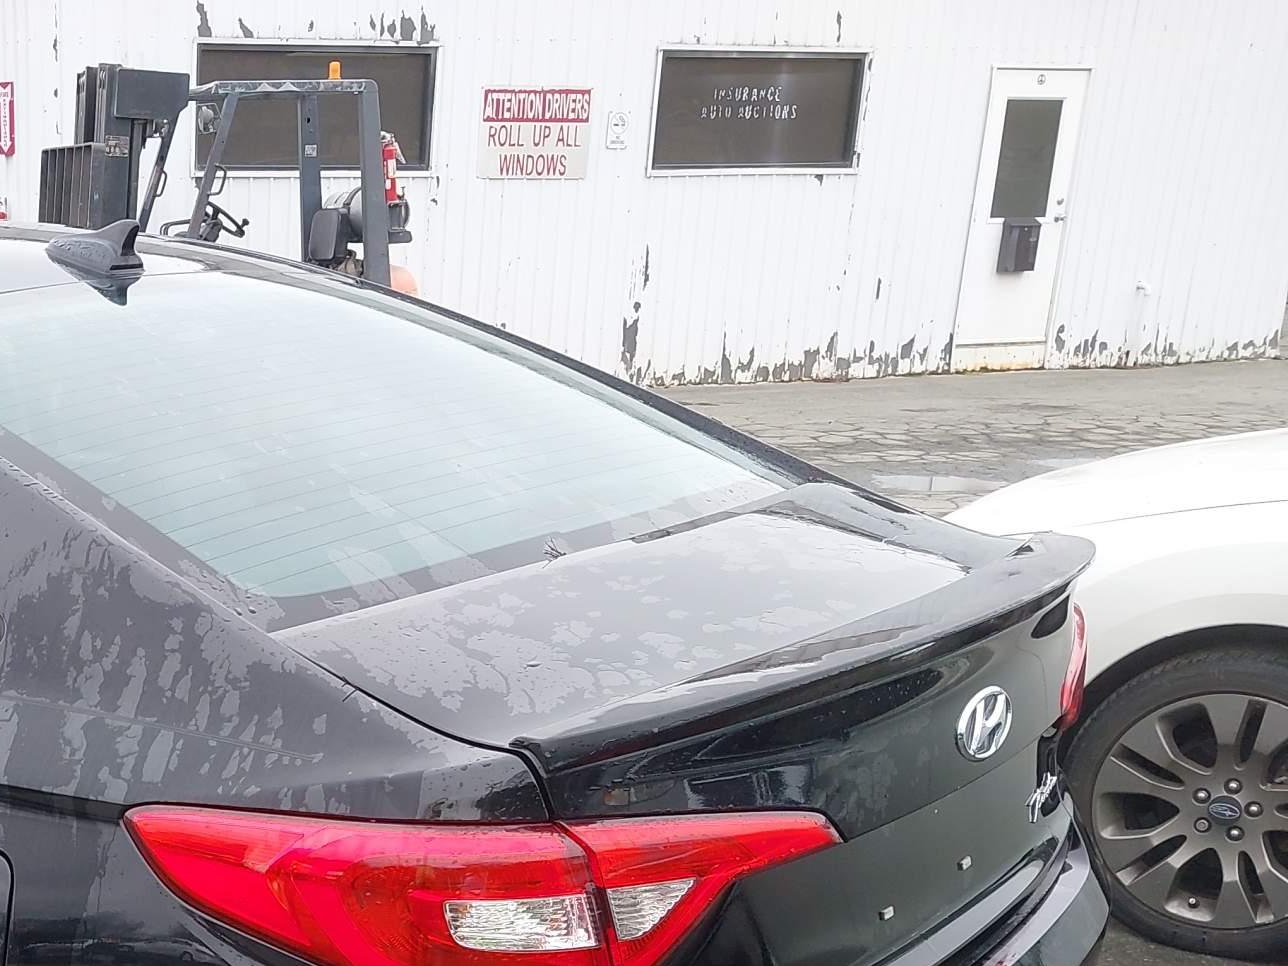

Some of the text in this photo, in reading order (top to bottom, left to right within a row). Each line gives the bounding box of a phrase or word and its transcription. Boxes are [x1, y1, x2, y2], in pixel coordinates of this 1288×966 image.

[484, 91, 591, 121] ATTENTION DRIVERS
[713, 86, 783, 102] INSURANCE
[700, 104, 798, 120] AUTO AUCTIONS
[487, 124, 581, 148] ROLL UP ALL
[498, 153, 568, 177] WINDOWS
